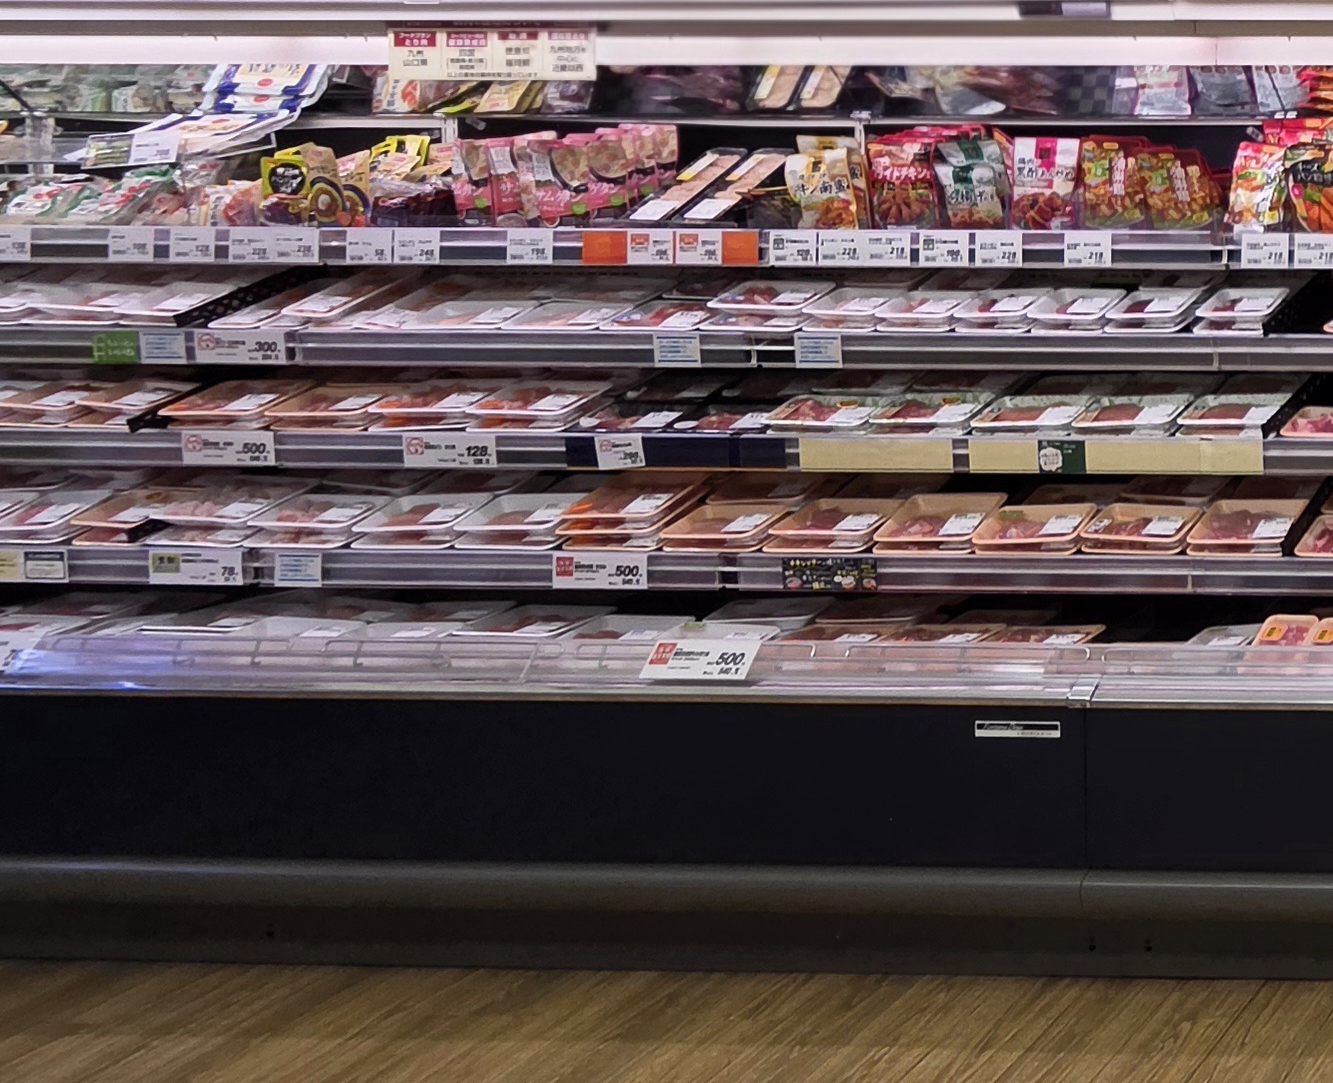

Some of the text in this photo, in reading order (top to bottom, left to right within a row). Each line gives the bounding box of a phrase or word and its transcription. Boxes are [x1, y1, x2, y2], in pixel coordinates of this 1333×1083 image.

[1267, 251, 1283, 260] 218
[1318, 251, 1333, 260] 218
[254, 340, 279, 353] 300
[242, 441, 267, 454] 500
[465, 444, 489, 457] 128
[220, 565, 237, 576] 78
[614, 564, 640, 577] 500
[714, 651, 744, 667] 500
